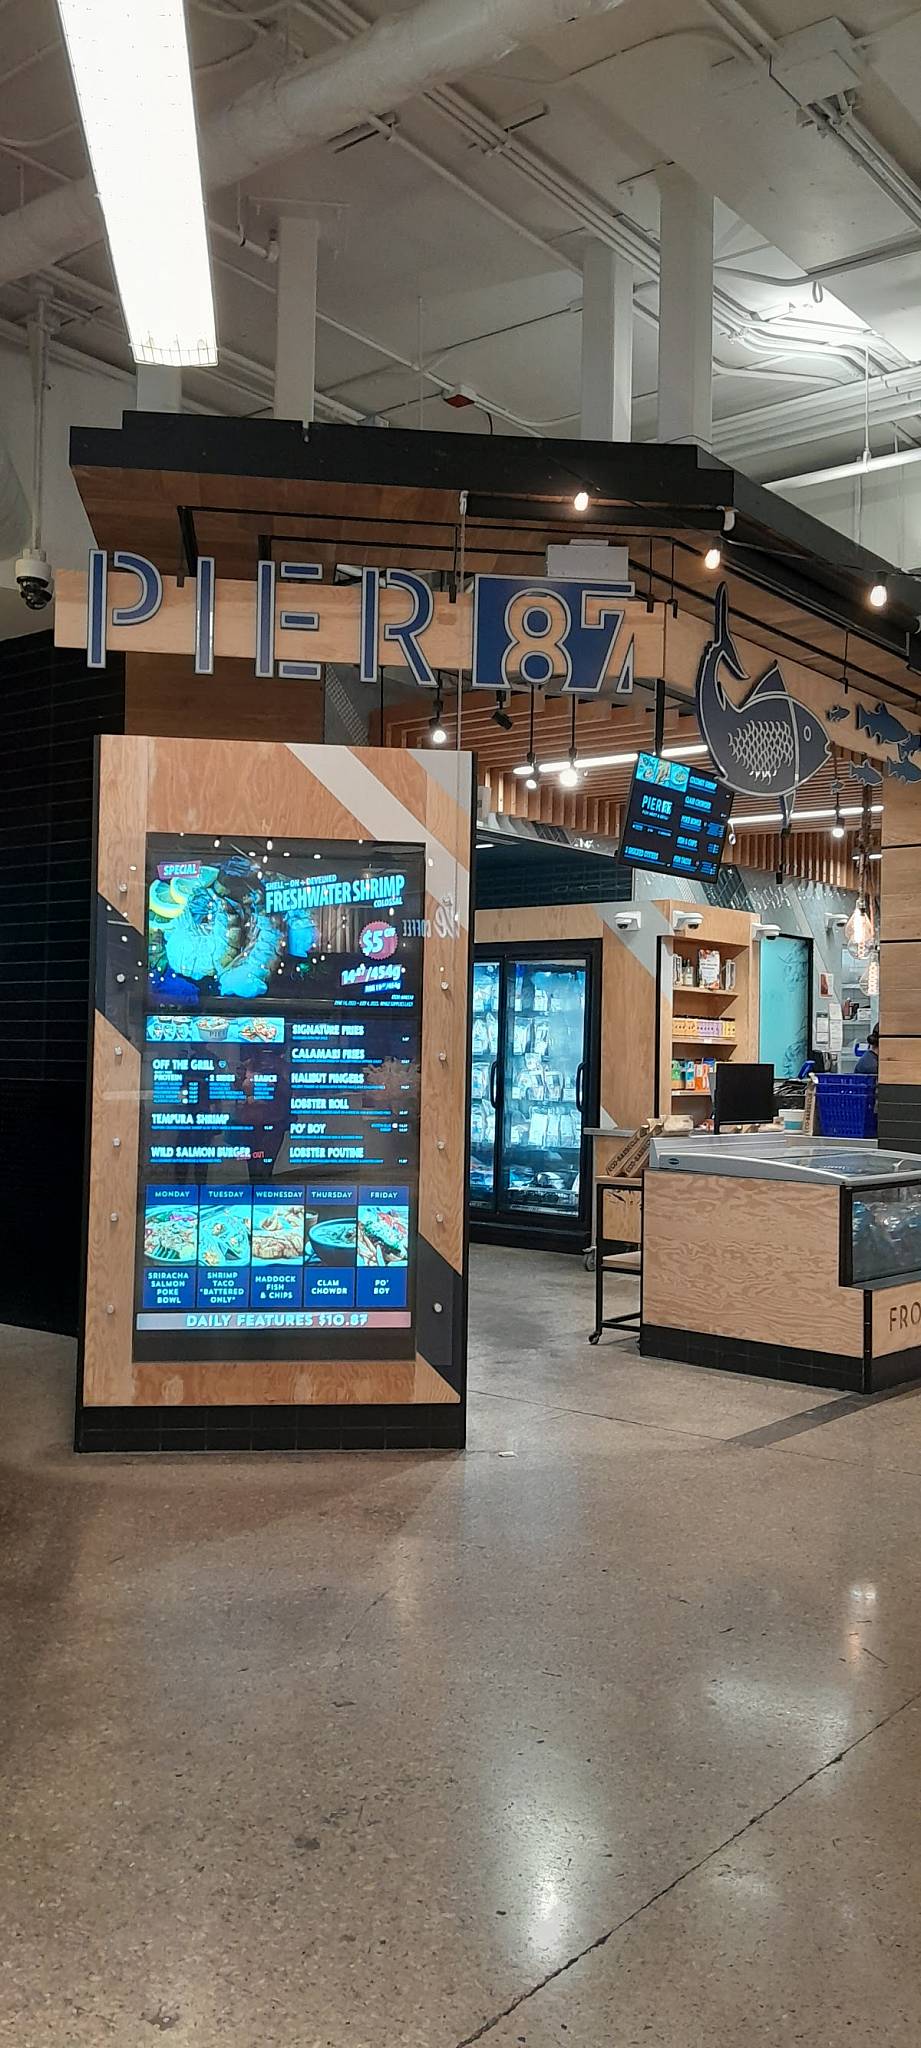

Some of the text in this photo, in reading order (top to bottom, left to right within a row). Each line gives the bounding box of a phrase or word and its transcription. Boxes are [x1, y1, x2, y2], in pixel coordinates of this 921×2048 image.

[87, 549, 636, 694] PIER 87
[641, 795, 663, 813] PIER
[164, 864, 197, 876] SPECIAL
[306, 874, 337, 886] DEVEINED
[266, 875, 405, 914] FRESHWATER SHRIMP
[373, 897, 403, 908] COLOSSAL
[292, 1024, 364, 1036] SIGNATURE FRIES
[291, 1048, 365, 1060] CALAMARI FRIES
[152, 1059, 215, 1071] OFF THE GRILL
[153, 1074, 183, 1082] PROTEIN
[290, 1073, 364, 1084] HALIBUT FINGERS
[290, 1098, 350, 1110] LOBSTER ROLL
[151, 1114, 230, 1125] TEMPURA SHRIMP
[307, 1123, 327, 1134] BOY
[150, 1147, 174, 1158] WILD
[175, 1147, 216, 1158] SALMON
[216, 1147, 251, 1159] BURGER
[289, 1147, 364, 1159] LOBSTER POUTINE
[311, 1191, 353, 1199] THURSDAY
[255, 1275, 296, 1283] HADDOCK
[316, 1279, 340, 1287] CLAM
[156, 1288, 179, 1296] POKE
[311, 1287, 348, 1295] CHOWDR
[373, 1287, 390, 1295] BOY
[156, 1296, 182, 1304] BOWL
[186, 1313, 369, 1327] DAILY FEATURES $10.87
